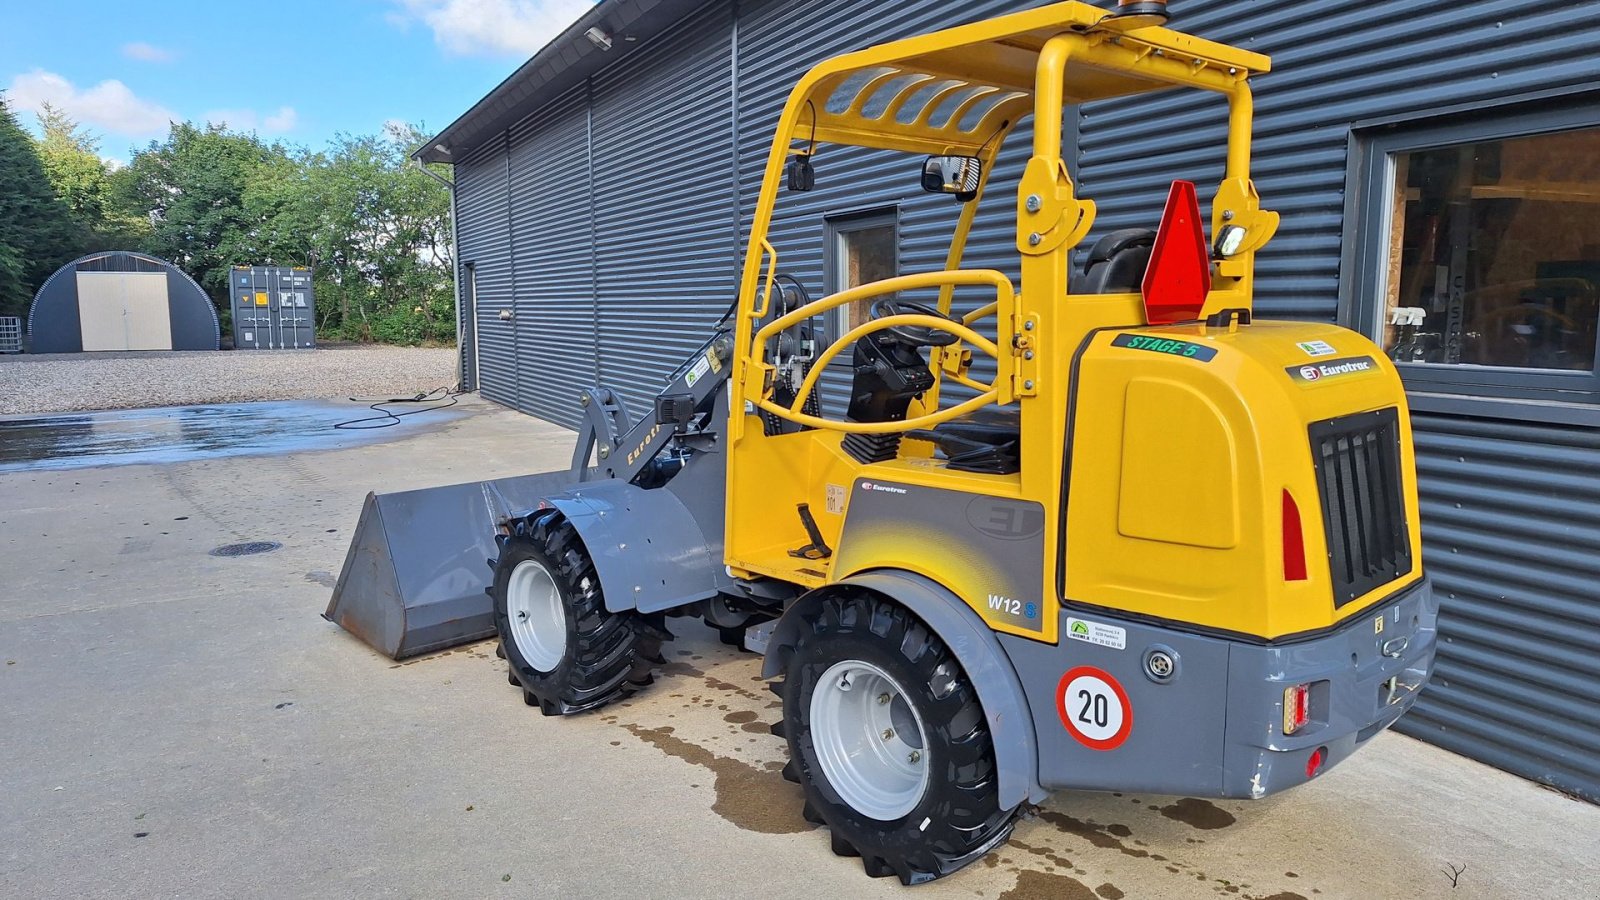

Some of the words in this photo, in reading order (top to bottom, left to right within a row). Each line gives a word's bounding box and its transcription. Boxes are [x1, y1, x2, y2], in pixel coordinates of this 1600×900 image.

[1126, 336, 1186, 354] STAGE
[1182, 345, 1200, 357] 5
[1319, 361, 1370, 377] Eurotrac
[872, 484, 908, 495] Eurotrac
[988, 594, 1021, 615] W12
[1023, 601, 1037, 619] S
[1078, 689, 1108, 728] 20
